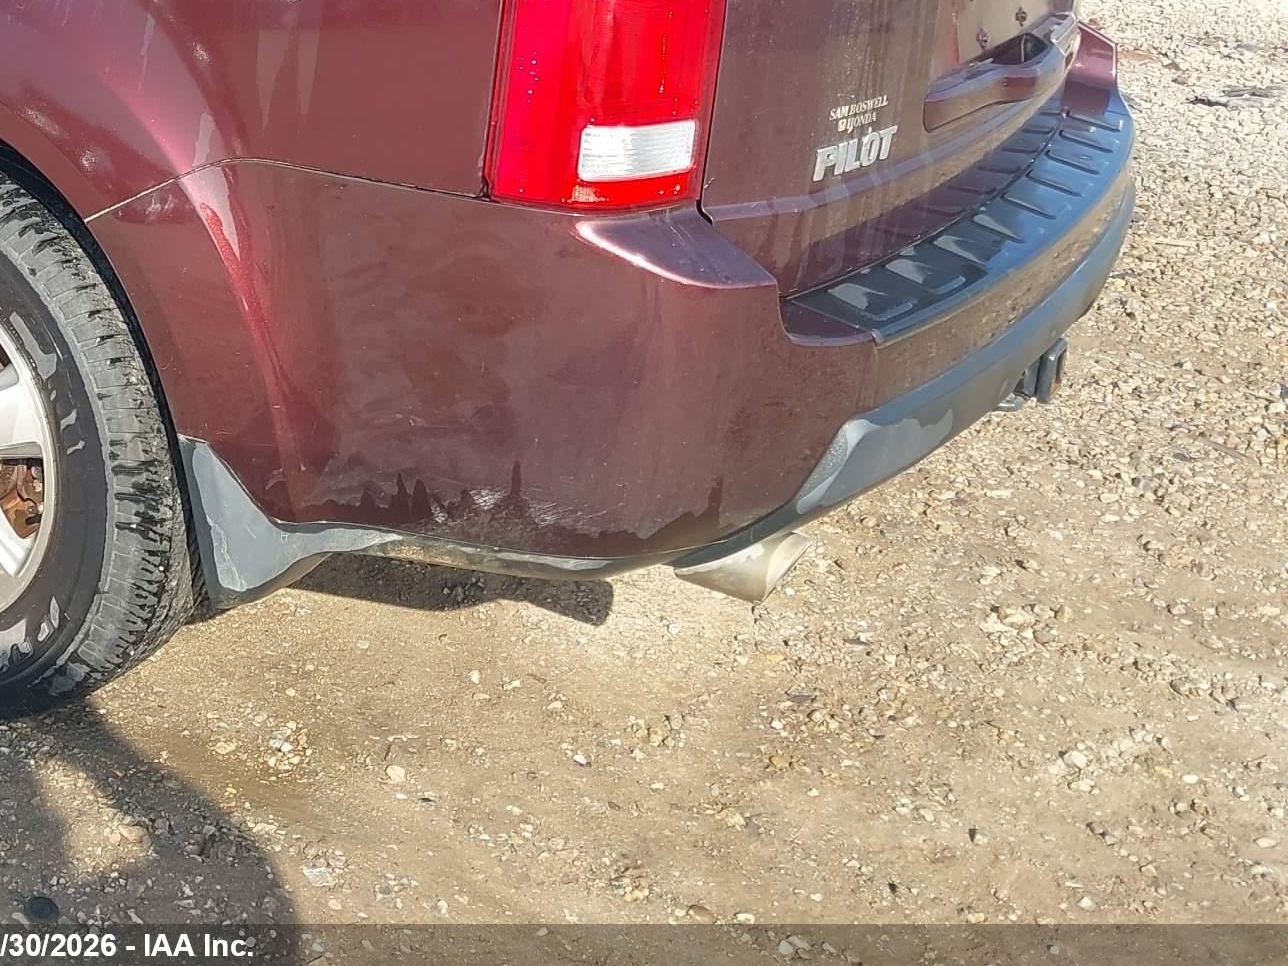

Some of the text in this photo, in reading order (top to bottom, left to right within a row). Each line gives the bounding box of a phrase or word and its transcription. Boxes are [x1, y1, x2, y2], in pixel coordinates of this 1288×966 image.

[829, 94, 888, 120] SAM BOSWELL
[847, 112, 876, 130] HONDA
[813, 125, 898, 182] PILOT
